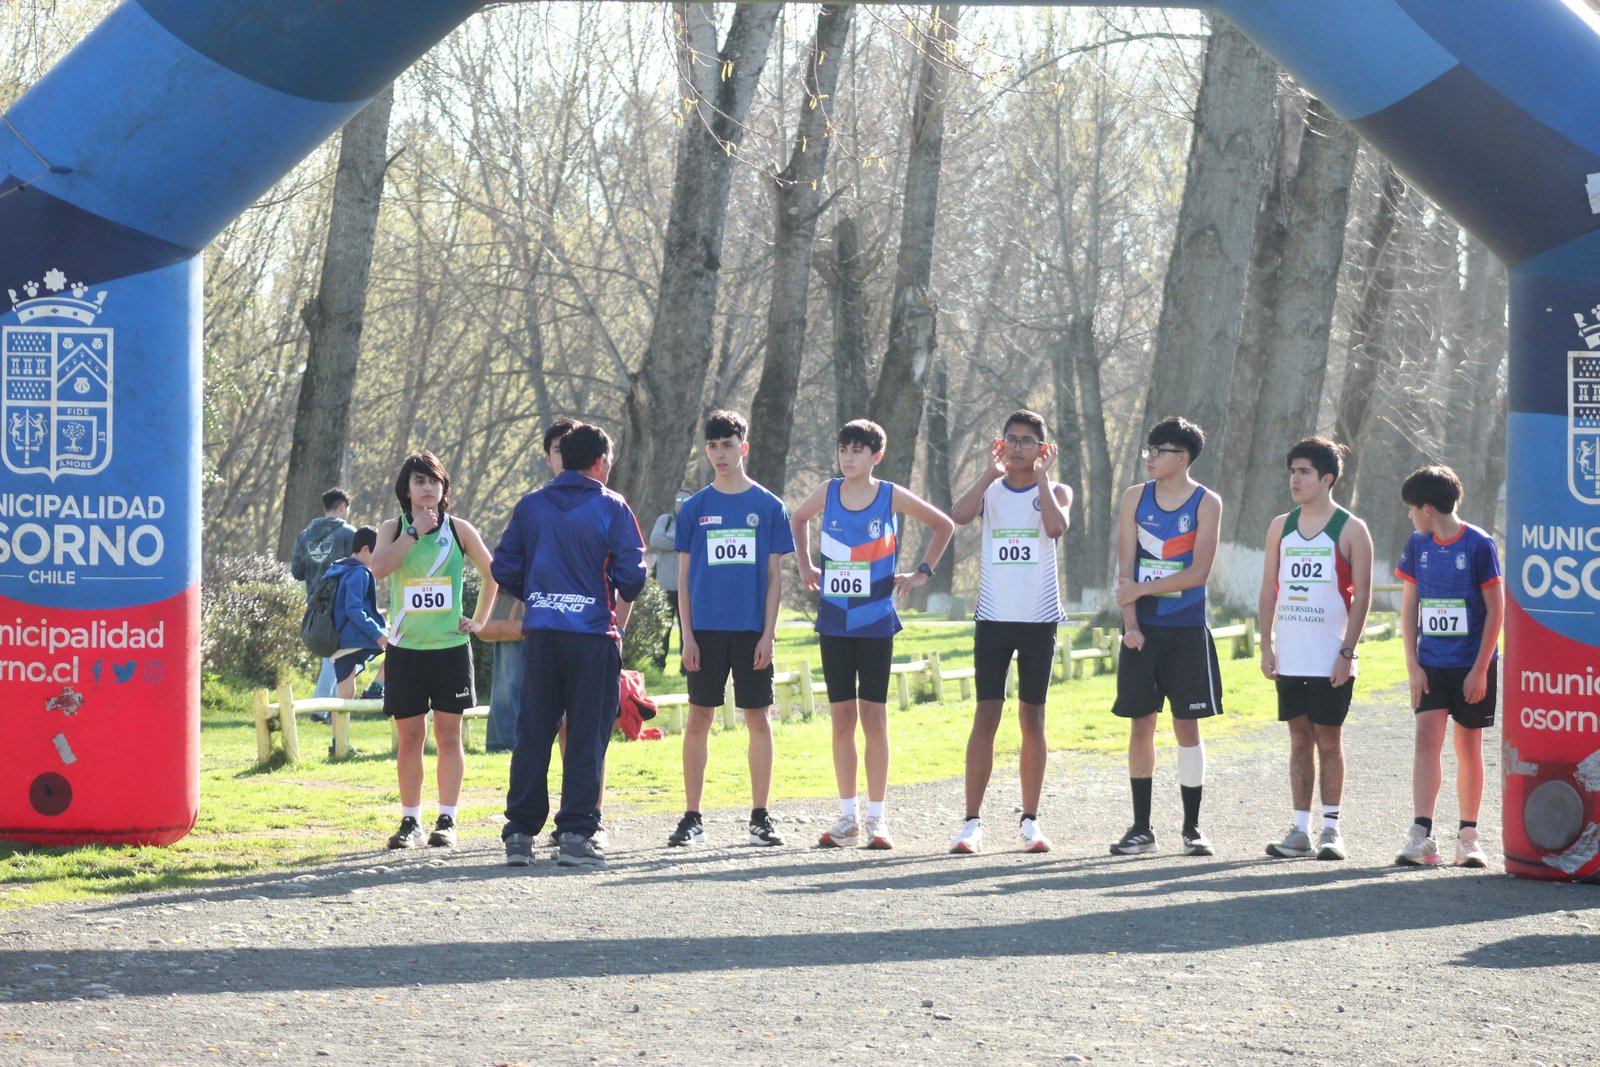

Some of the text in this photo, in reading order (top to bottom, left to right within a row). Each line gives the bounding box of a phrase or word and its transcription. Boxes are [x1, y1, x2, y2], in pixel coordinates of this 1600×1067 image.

[67, 408, 89, 416] FIDE
[98, 431, 106, 442] ET
[60, 459, 92, 468] AMORE
[715, 544, 747, 560] 004
[999, 546, 1031, 561] 003
[28, 570, 76, 584] CHILE
[1291, 562, 1322, 578] 002
[831, 578, 862, 593] 006
[412, 592, 445, 608] 050
[1299, 615, 1325, 623] LAGOS
[1429, 616, 1459, 631] 007
